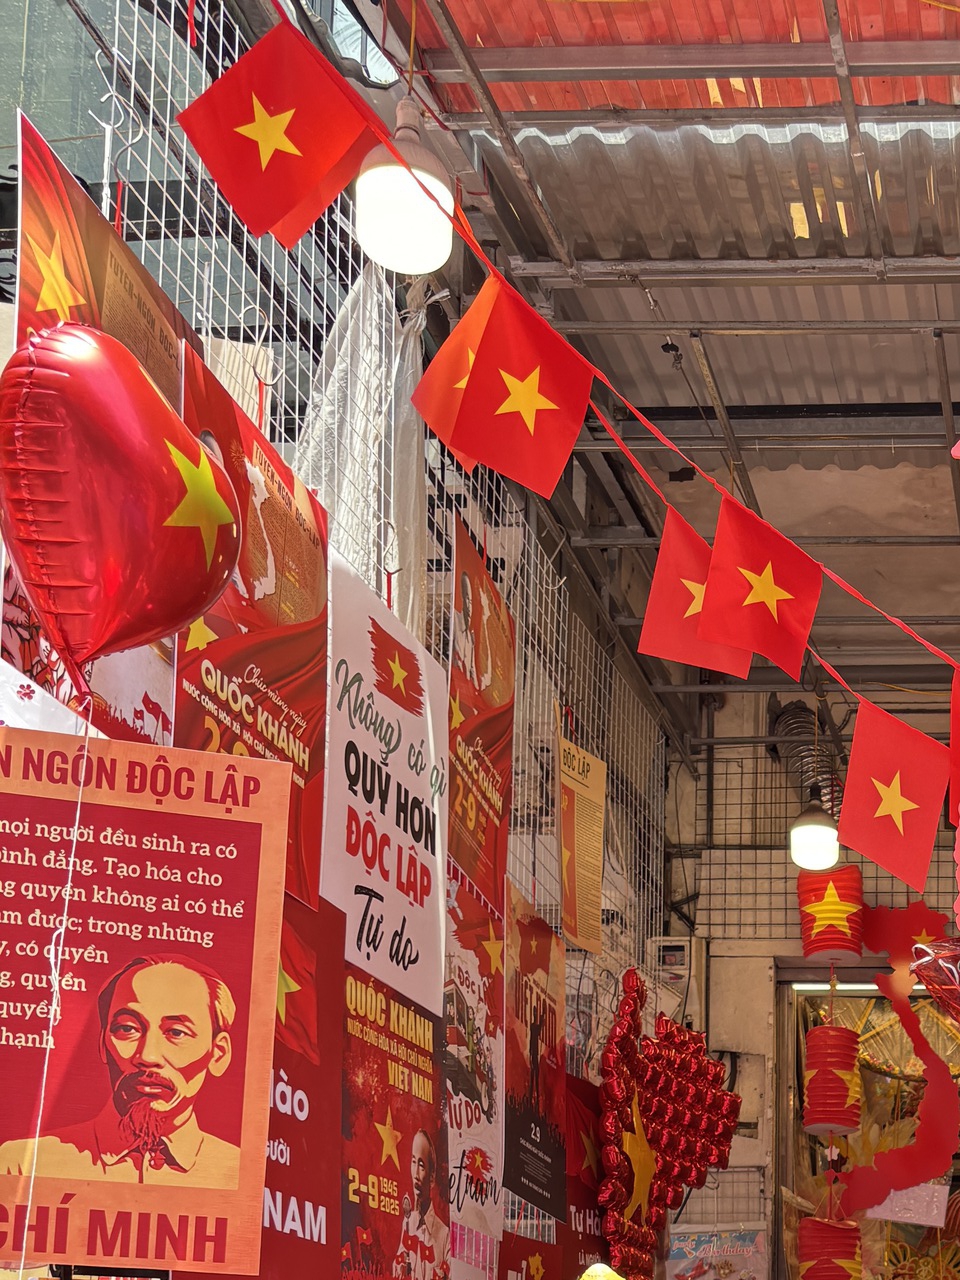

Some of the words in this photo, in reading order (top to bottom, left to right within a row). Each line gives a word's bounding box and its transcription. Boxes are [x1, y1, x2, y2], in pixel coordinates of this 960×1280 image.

[201, 659, 254, 724] QUỐC
[257, 705, 309, 772] KHÁNH
[335, 659, 402, 762] Không
[408, 739, 426, 776] có
[22, 745, 117, 790] NGÔN
[126, 755, 195, 805] ĐỘC
[204, 764, 261, 814] LẬP
[35, 823, 95, 843] người
[100, 827, 137, 848] đều
[142, 833, 185, 854] sinh
[190, 841, 211, 857] ra
[215, 843, 238, 859] có
[396, 781, 437, 857] HƠN
[0, 847, 37, 867] ình
[42, 849, 98, 876] đẳng.
[103, 857, 141, 879] Tạo
[145, 861, 181, 883] hóa
[187, 867, 223, 887] cho
[345, 804, 391, 882] ĐỘC
[396, 844, 432, 909] LẬP
[20, 881, 87, 902] quyền
[92, 885, 157, 912] không
[161, 894, 180, 912] ai
[184, 898, 207, 915] có
[211, 899, 245, 918] thể
[15, 940, 39, 957] có
[88, 916, 143, 940] trong
[148, 922, 214, 948] những
[354, 884, 384, 961] Tự
[389, 916, 420, 971] do
[346, 976, 386, 1027] QUỐC
[390, 999, 433, 1054] KHÁNH
[387, 1059, 409, 1094] VIỆT
[412, 1070, 433, 1104] NAM
[348, 1168, 378, 1209] 2-9
[380, 1176, 398, 1197] 1945
[449, 1149, 501, 1212] etnam
[263, 1187, 327, 1245] NAM
[380, 1195, 400, 1216] 2025
[570, 1205, 584, 1240] Tự
[586, 1208, 601, 1237] Hà
[87, 1209, 228, 1263] MINH
